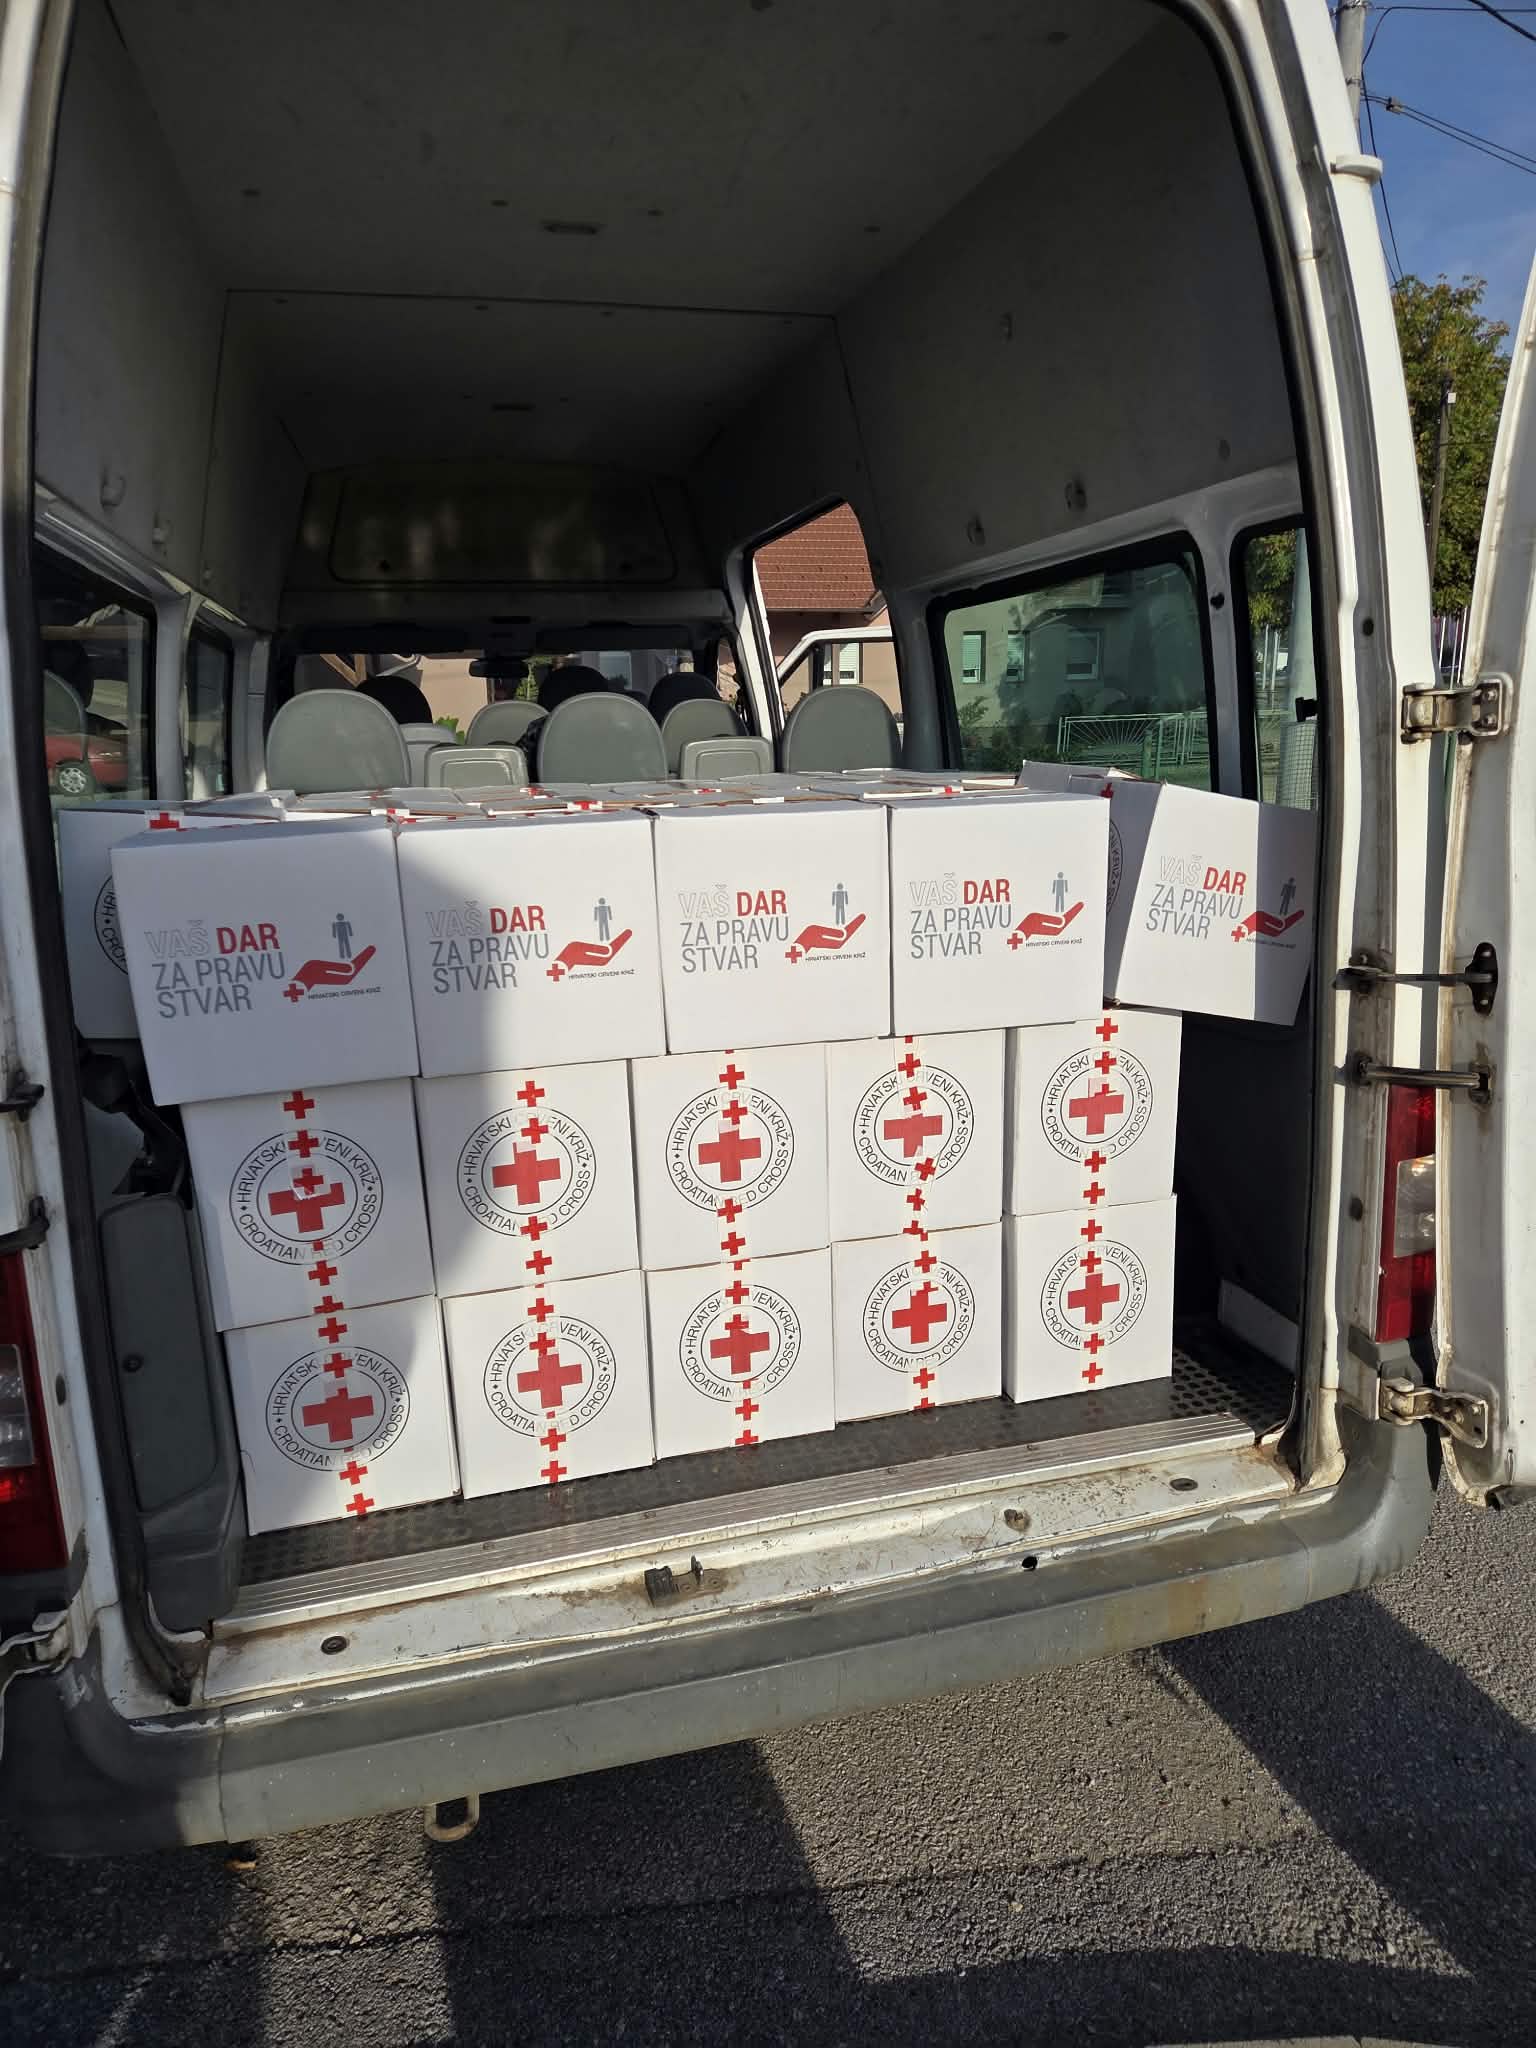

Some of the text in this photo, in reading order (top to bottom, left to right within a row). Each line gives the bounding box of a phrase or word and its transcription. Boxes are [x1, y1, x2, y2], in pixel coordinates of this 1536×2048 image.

[909, 872, 1011, 906] VAŠ DAR
[1160, 854, 1247, 895] VAŠ DAR
[425, 900, 546, 937] VAŠ DAR
[678, 884, 788, 919] VAŠ DAR
[910, 904, 1012, 934] ZA PRAVU
[1150, 884, 1243, 920] ZA PRAVU
[144, 919, 210, 959] VAŠ
[216, 922, 280, 954] DAR
[680, 916, 790, 947] ZA PRAVU
[1146, 908, 1211, 940] STVAR
[429, 933, 550, 967] ZA PRAVU
[681, 945, 759, 973] STVAR
[910, 931, 982, 959] STVAR
[152, 952, 286, 991] ZA PRAVU
[433, 963, 518, 994] STVAR
[158, 983, 253, 1019] STVAR
[1047, 1055, 1090, 1106] HRVATSKI
[1131, 1070, 1150, 1100] KRIŽ
[859, 1076, 899, 1127] HRVATSK
[950, 1090, 971, 1120] KRIŽ
[672, 1095, 718, 1151] HRVATSKI
[768, 1111, 791, 1142] KRIŽ
[1117, 1105, 1147, 1147] CROSS
[464, 1117, 512, 1176] HRVATSKI
[566, 1131, 593, 1163] KRIŽ
[858, 1126, 968, 1182] CROATIAN CROSS
[351, 1153, 379, 1187] KRIŽ
[757, 1149, 788, 1194] CROSS
[558, 1170, 591, 1216] CROSS
[344, 1193, 378, 1243] CROSS
[868, 1268, 909, 1319] HRVATSKI
[953, 1281, 972, 1309] KRIŽ
[1127, 1261, 1145, 1288] KRIŽ
[685, 1298, 723, 1347] HRVATSK
[776, 1307, 798, 1335] KRIŽ
[1045, 1293, 1142, 1346] CROATIA CROSS
[588, 1338, 612, 1367] KRIŽ
[868, 1328, 914, 1368] CROATIAN
[942, 1314, 970, 1354] CROSS
[766, 1341, 795, 1383] CROSS
[272, 1359, 318, 1416] HRVATSK
[380, 1368, 406, 1398] KRIŽ
[580, 1373, 610, 1418] CROSS
[372, 1404, 404, 1449] CROSS
